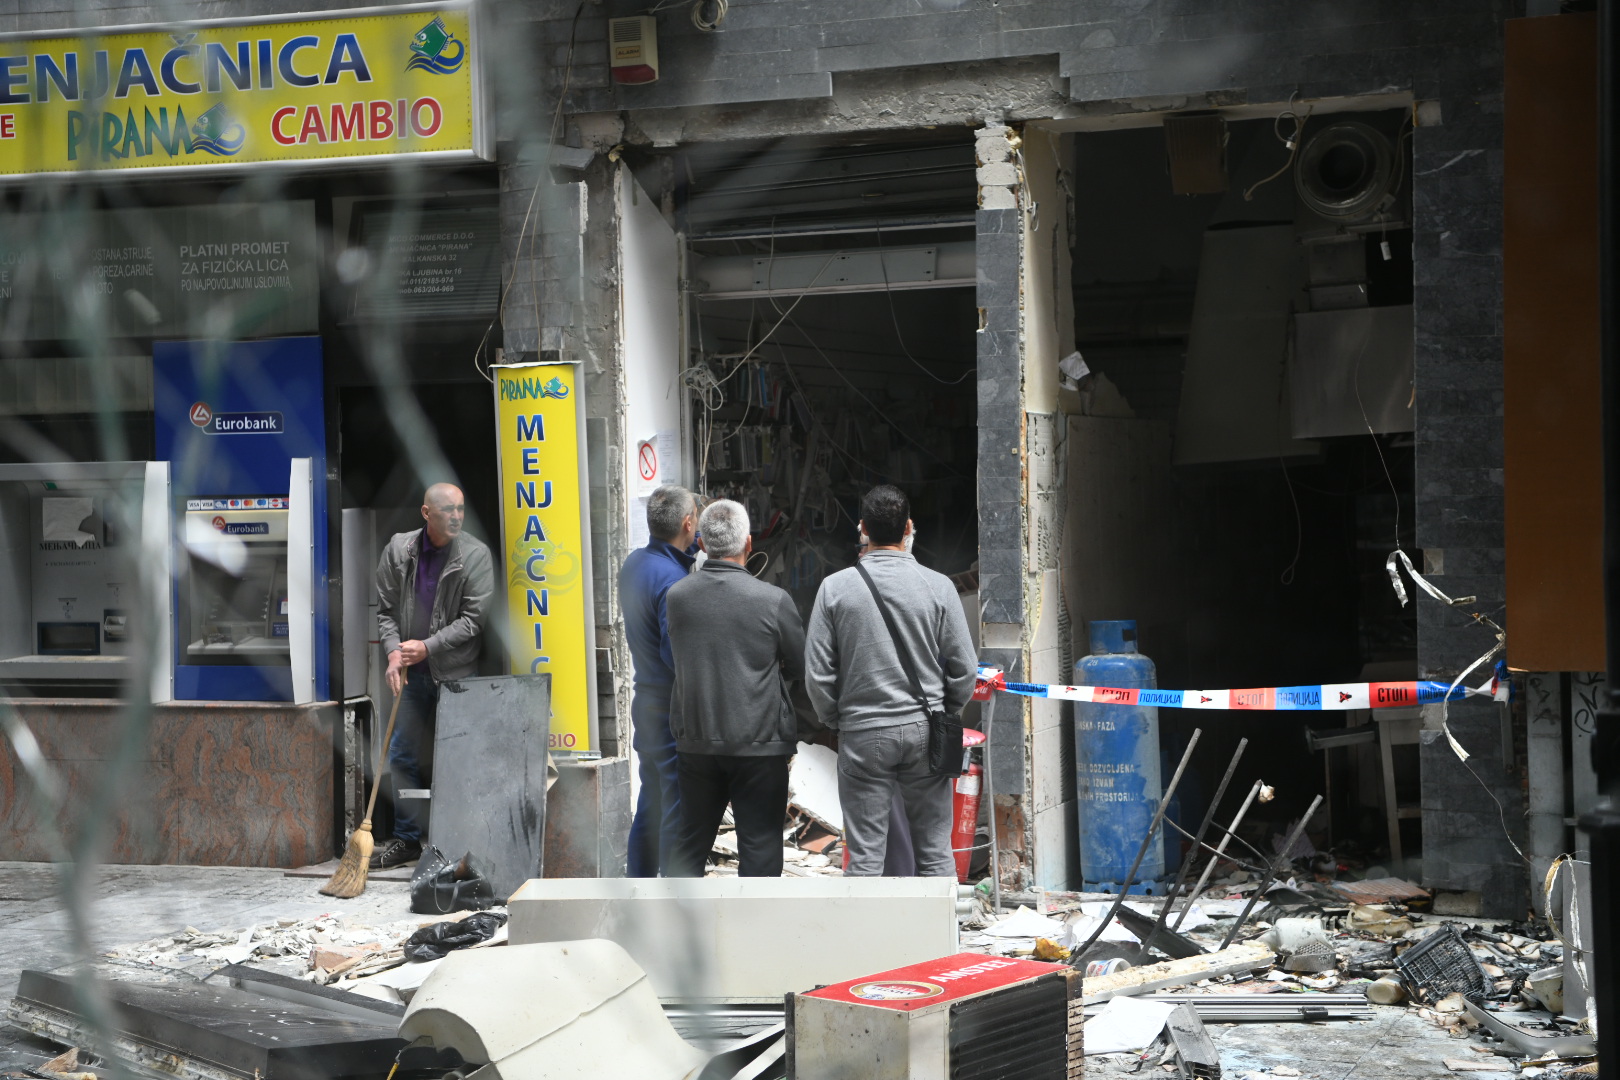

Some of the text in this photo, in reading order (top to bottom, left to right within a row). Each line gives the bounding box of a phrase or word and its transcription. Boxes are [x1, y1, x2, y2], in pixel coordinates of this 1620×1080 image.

[270, 97, 442, 145] CAMBIO
[180, 241, 290, 258] PLATNI PROMET
[182, 257, 289, 275] ZA FIZIČKA LICA
[181, 279, 192, 291] PO
[215, 416, 277, 430] Eurobank
[227, 525, 265, 533] Eurobank
[516, 413, 553, 718] MENJAČNIC
[1140, 693, 1181, 704] ПОЛИЦИЈА
[1277, 691, 1320, 706] ПОЛИЦИЈА
[1378, 687, 1408, 702] СТОП
[1097, 721, 1116, 731] FAZA
[928, 960, 1018, 983] AMSTEL
